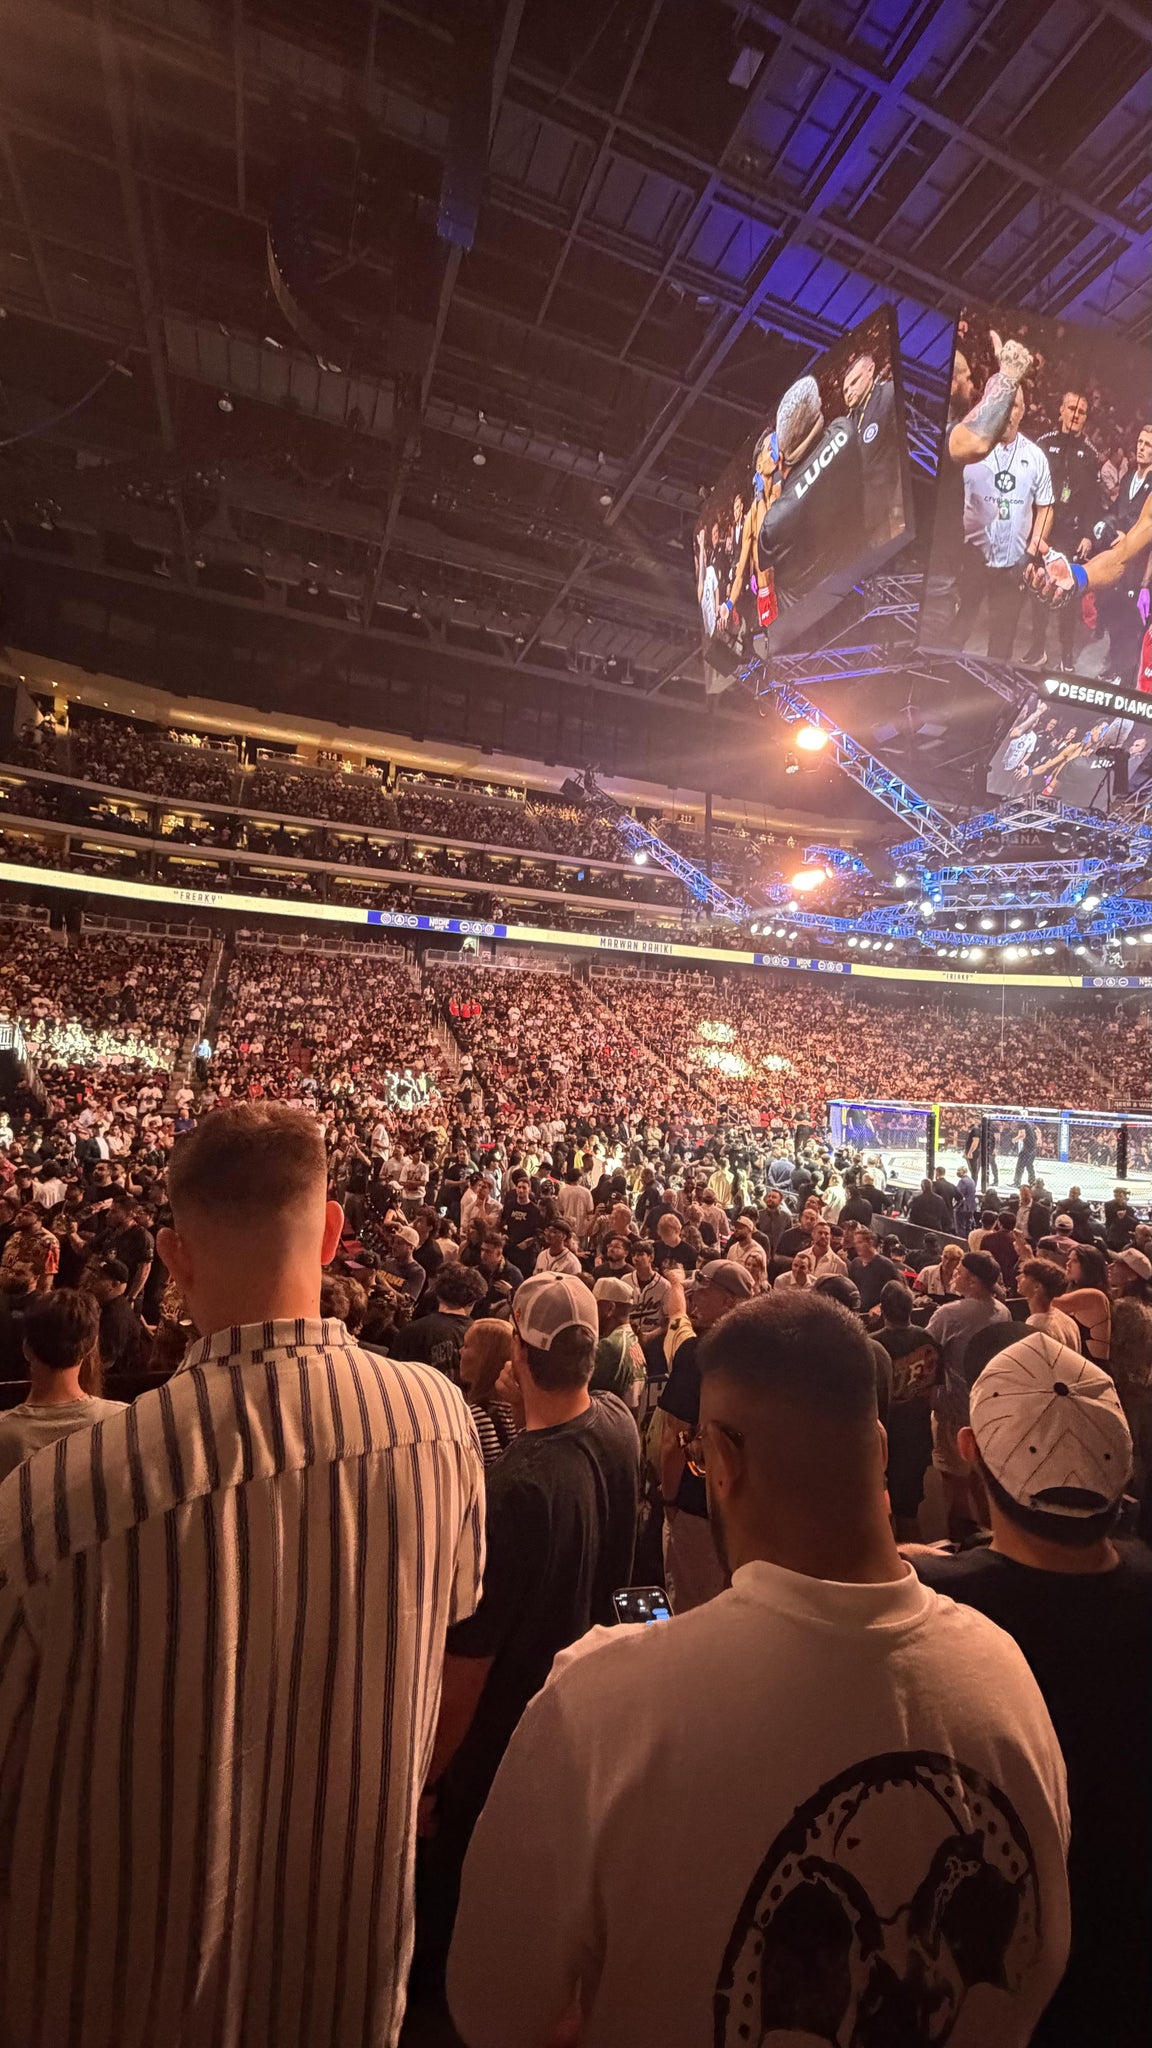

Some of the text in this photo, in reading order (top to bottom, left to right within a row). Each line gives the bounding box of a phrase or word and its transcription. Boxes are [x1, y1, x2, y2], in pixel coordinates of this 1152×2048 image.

[795, 431, 848, 499] LUCIO
[1059, 682, 1113, 707] DESERT
[322, 751, 338, 761] 214
[173, 890, 223, 903] "FREAKY"
[600, 937, 673, 955] MARWAN RAHIKI
